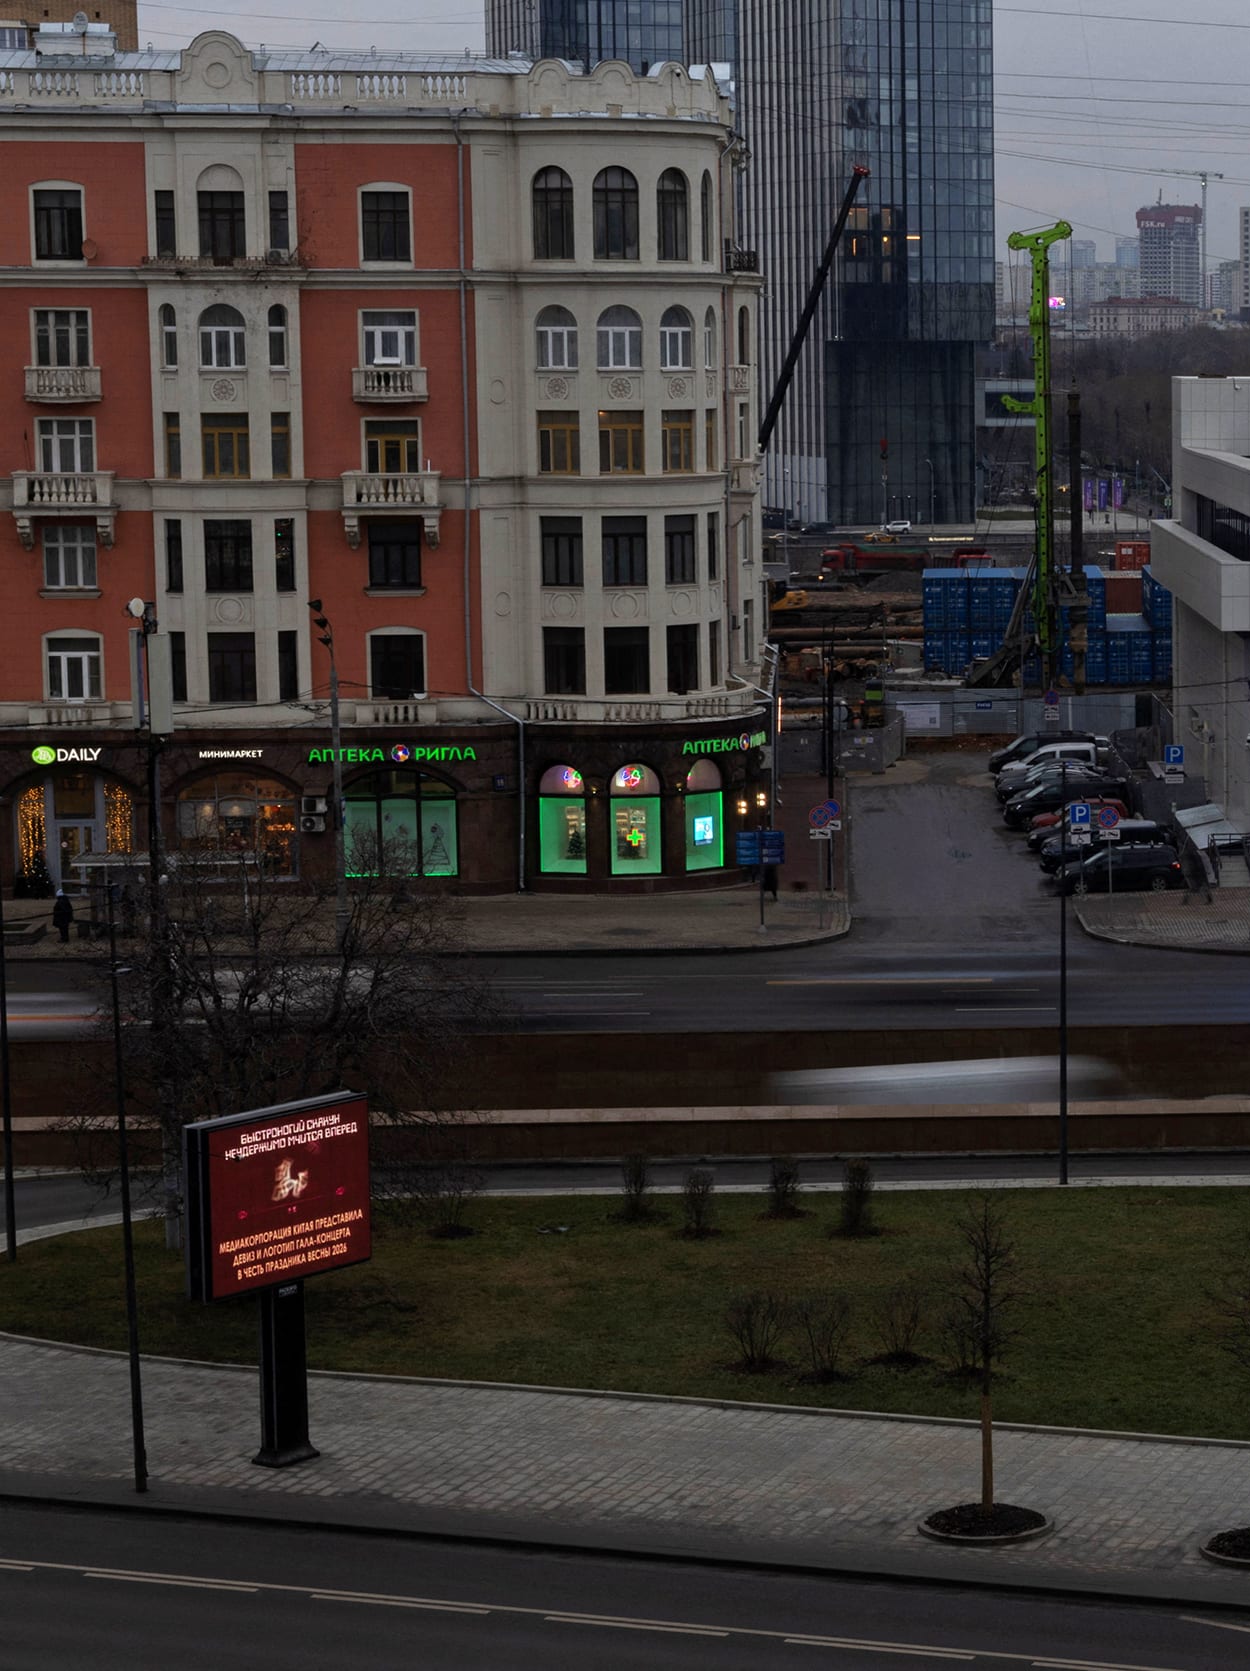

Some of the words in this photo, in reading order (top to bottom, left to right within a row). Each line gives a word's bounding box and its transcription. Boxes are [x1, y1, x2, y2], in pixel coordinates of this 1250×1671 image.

[56, 747, 102, 762] DAILY
[198, 749, 264, 759] МИНИМАРКЕТ
[308, 748, 385, 763] АПТЕКА
[415, 746, 477, 761] РИГЛА
[682, 737, 740, 755] АПТЕКА
[225, 1137, 287, 1160] НЕУДЕРЖИМО
[287, 1130, 324, 1147] МЧИТСЯ
[325, 1122, 358, 1138] ВПЕРЕД
[240, 1119, 305, 1145] БЫСТРОНОГИЙ
[306, 1113, 341, 1130] СКАКУН
[219, 1226, 292, 1254] МЕДИАКОРПОРАЦИЯ
[293, 1220, 315, 1235] КИТАЯ
[315, 1208, 363, 1230] ПРЕДСТАВИЛА
[233, 1251, 256, 1267] ДЕВИЗ
[256, 1249, 262, 1259] И
[263, 1240, 296, 1259] ЛОГОТИП
[296, 1227, 351, 1251] ГАЛА-КОНЦЕРТА
[237, 1269, 243, 1281] В
[243, 1264, 265, 1279] ЧЕСТЬ
[265, 1253, 307, 1273] ПРАЗДНИКА
[307, 1247, 331, 1262] ВЕСНЫ
[332, 1242, 348, 1256] 2026
